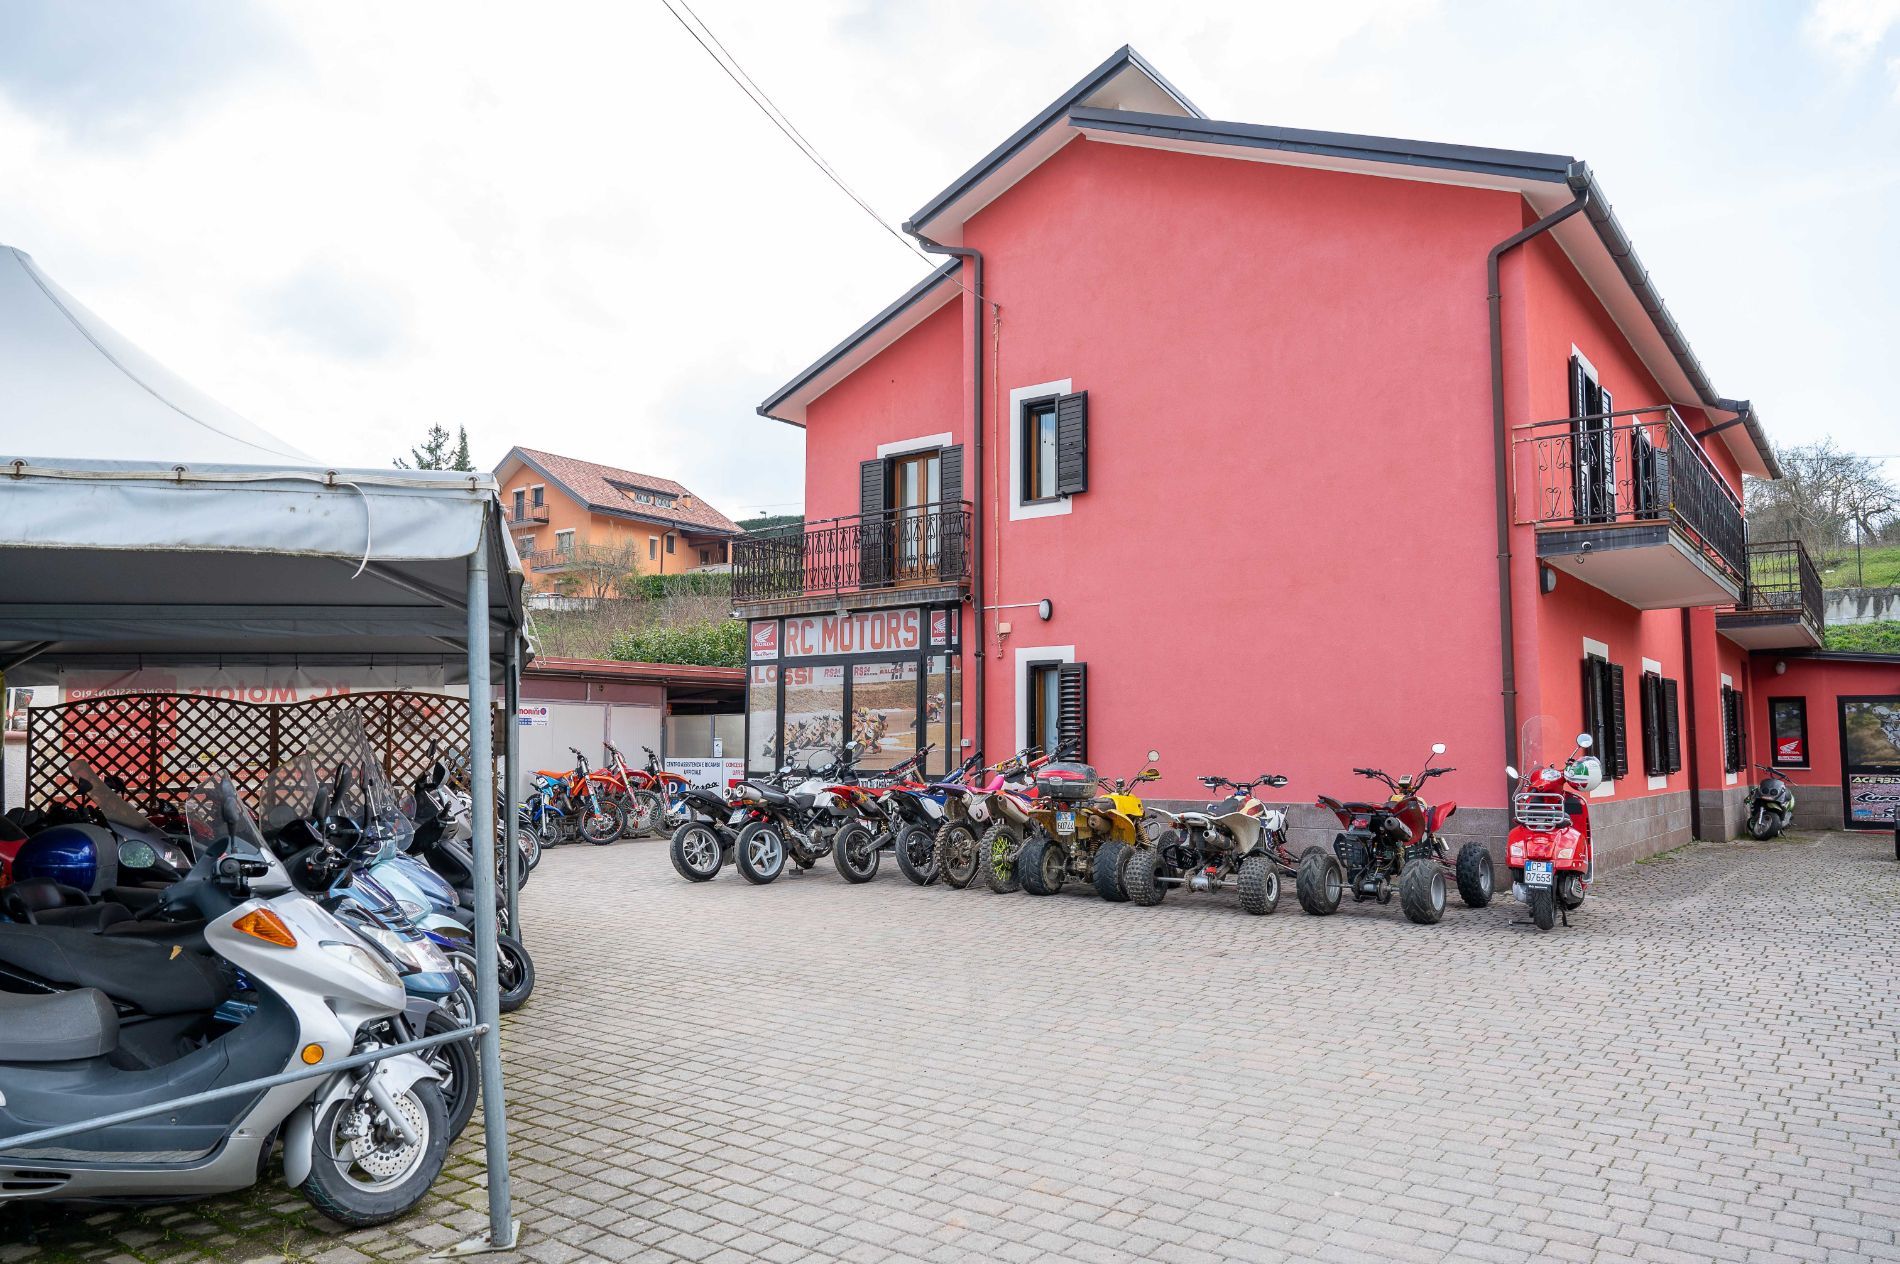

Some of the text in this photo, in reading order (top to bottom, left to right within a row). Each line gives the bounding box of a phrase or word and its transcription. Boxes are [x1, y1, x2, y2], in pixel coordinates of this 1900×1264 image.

[786, 611, 918, 655] RC MOTORS
[1526, 873, 1551, 882] 07653
